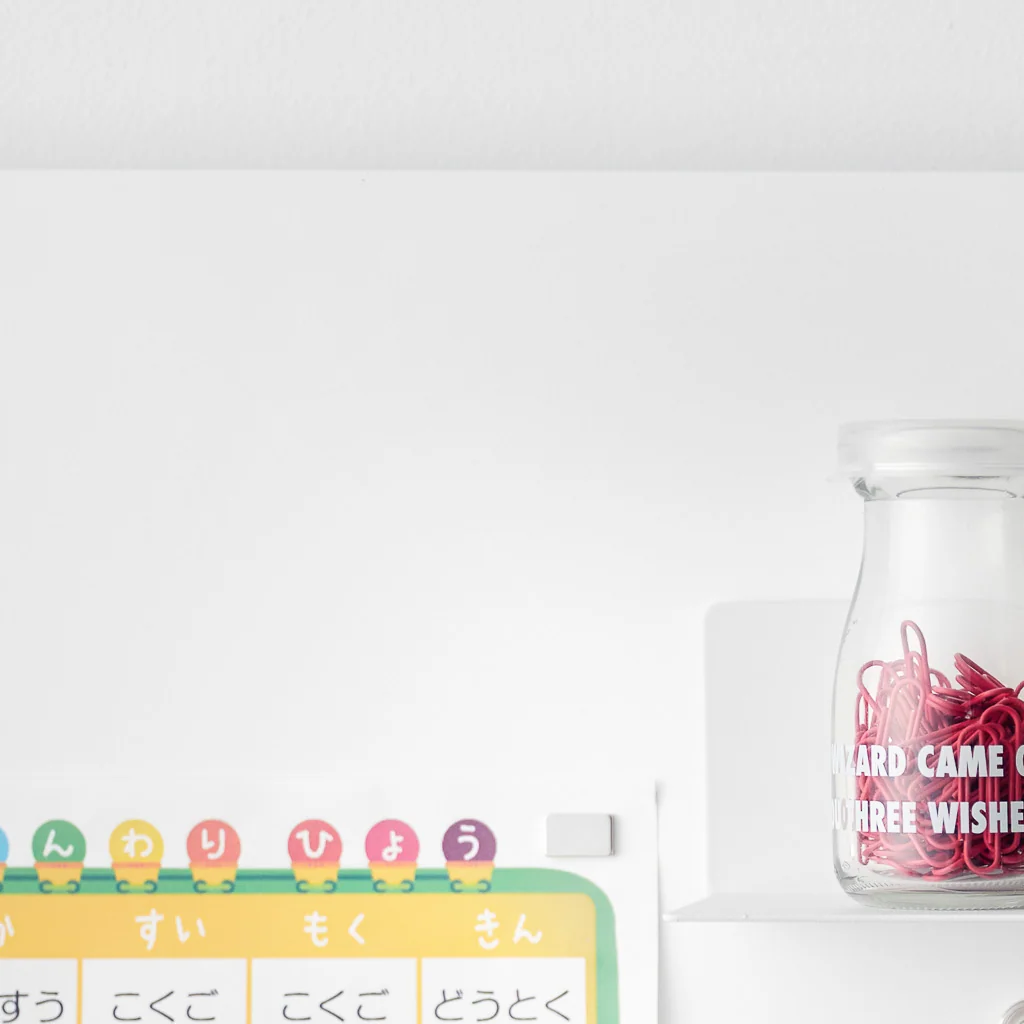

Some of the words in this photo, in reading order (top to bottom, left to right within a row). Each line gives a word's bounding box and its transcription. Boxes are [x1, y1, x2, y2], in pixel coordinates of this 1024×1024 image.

[917, 744, 1004, 778] CAME
[135, 908, 206, 950] すい
[303, 910, 365, 947] もく
[474, 908, 543, 950] きん
[0, 989, 64, 1024] すう
[112, 989, 219, 1022] こくご
[282, 989, 389, 1022] こくご
[434, 989, 570, 1022] どうとく
